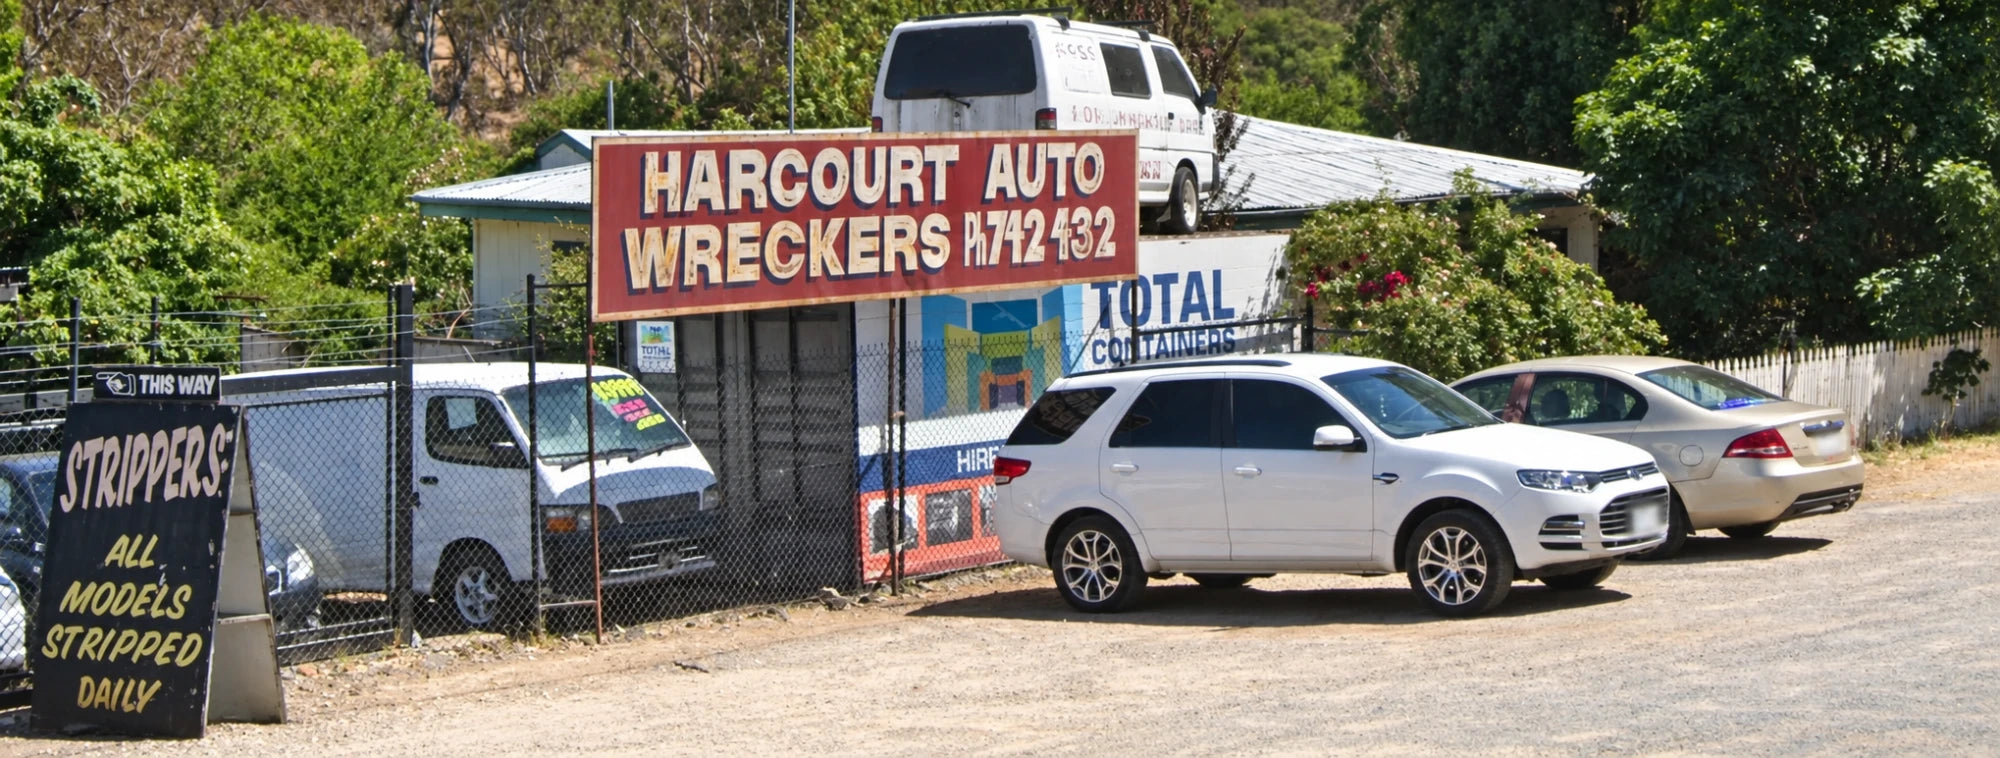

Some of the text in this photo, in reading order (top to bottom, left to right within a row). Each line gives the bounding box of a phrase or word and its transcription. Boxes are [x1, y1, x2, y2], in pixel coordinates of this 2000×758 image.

[643, 141, 1105, 214] HARCOURT AUTO
[624, 212, 951, 290] WRECKERS
[1091, 269, 1235, 329] TOTAL
[1092, 327, 1236, 365] CONTAINERS
[139, 374, 216, 395] THIS WAY
[104, 534, 160, 569] ALL
[59, 580, 193, 620] MODELS
[41, 623, 204, 668] STRIPPED
[77, 675, 163, 714] DAILY
